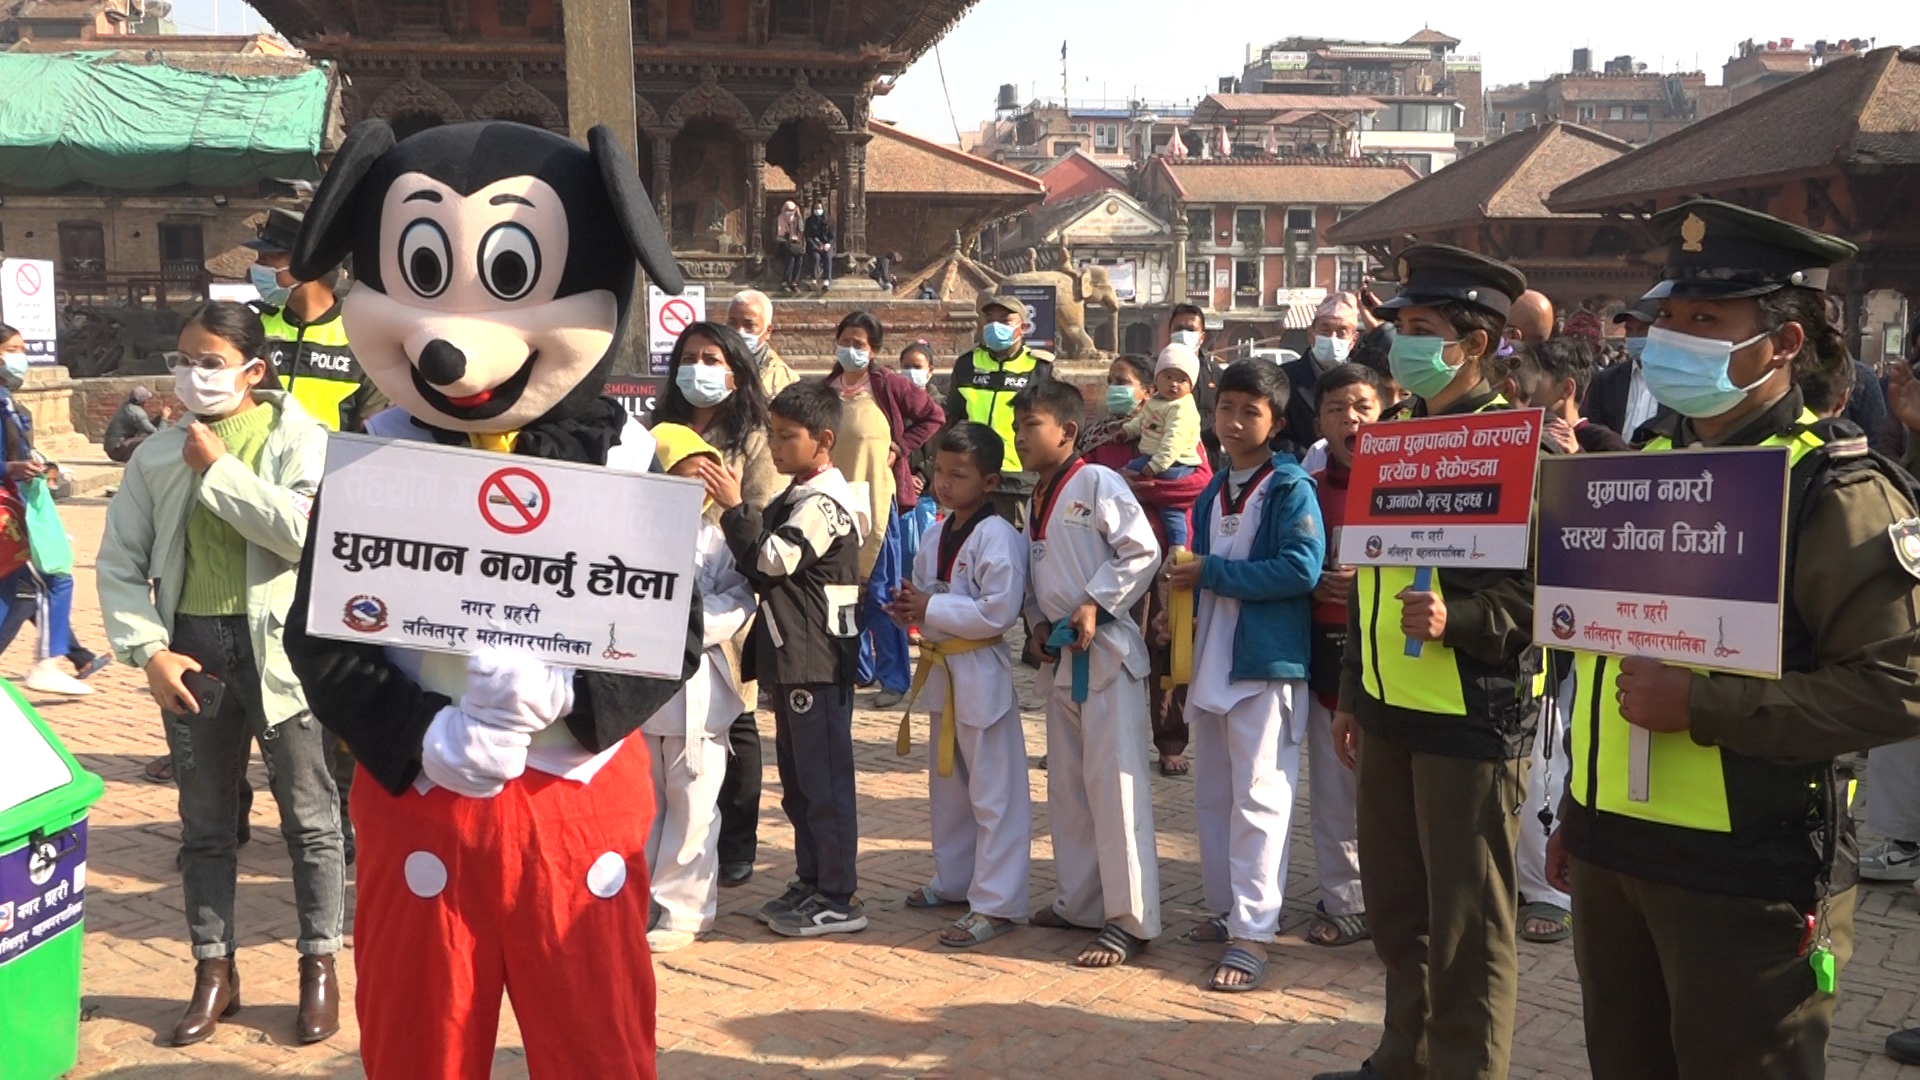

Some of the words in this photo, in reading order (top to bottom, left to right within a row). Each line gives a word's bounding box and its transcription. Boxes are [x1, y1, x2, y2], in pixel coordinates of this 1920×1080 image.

[310, 351, 351, 372] POLICE
[604, 383, 657, 396] SMOKING
[1473, 420, 1532, 446] कारणले
[1378, 459, 1418, 483] प्रत्येक
[1421, 463, 1431, 479] ७
[1435, 455, 1499, 480] सेकेण्डमा
[1376, 495, 1384, 510] १
[1386, 489, 1424, 510] जनाको
[1425, 493, 1453, 513] मृत्यु
[1454, 492, 1484, 513] हुन्छ
[1560, 526, 1607, 551] स्वस्थ
[1612, 521, 1666, 552] जीवन
[332, 531, 469, 576] धुम्रपान
[480, 549, 578, 597] नगर्नु
[586, 555, 680, 602] होला
[461, 600, 496, 619] नगर
[504, 603, 541, 625] प्रहरी
[1616, 601, 1639, 618] नगर
[1642, 600, 1668, 623] प्रहरी
[402, 616, 469, 648] ललितपुर
[476, 629, 592, 656] महानगरपालिका
[1583, 622, 1622, 650] ललितपुर
[1627, 630, 1707, 655] महानगरपालिका
[17, 897, 41, 919] नगर
[45, 879, 69, 908] प्रहरी
